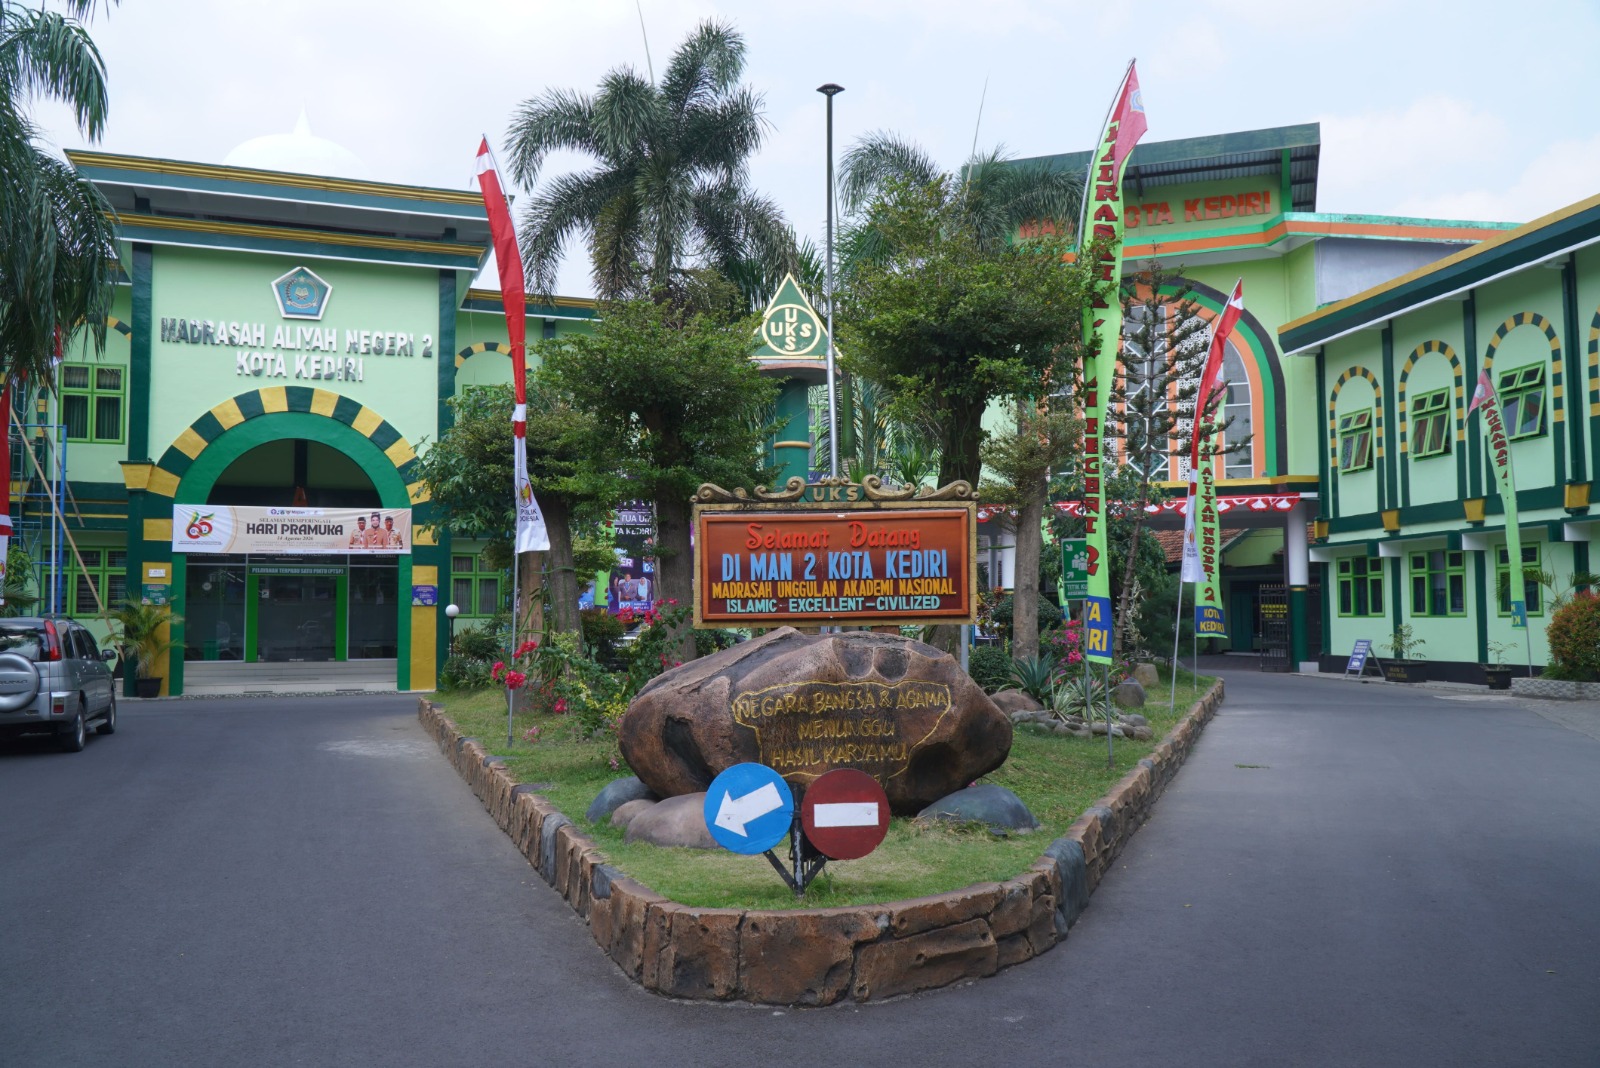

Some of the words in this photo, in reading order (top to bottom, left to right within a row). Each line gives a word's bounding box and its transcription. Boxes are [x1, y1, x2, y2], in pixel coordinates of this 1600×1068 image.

[1124, 201, 1174, 228] OTA
[1184, 191, 1272, 222] KEDIRI
[161, 317, 265, 347] MADRASAH
[273, 324, 337, 352] ALIYAH
[346, 330, 414, 357] NEGERI
[422, 334, 433, 358] 2
[770, 321, 812, 338] UKS
[237, 351, 287, 377] KOTA
[295, 355, 363, 382] KEDIRI
[813, 487, 858, 501] UKS
[1201, 467, 1215, 523] ALIYAH
[246, 523, 277, 534] HARI
[281, 524, 344, 536] PRAMUKA
[745, 522, 829, 549] Selamat
[848, 521, 920, 549] Datang
[722, 553, 740, 581] DI
[751, 552, 792, 581] MAN
[803, 553, 817, 580] 2
[828, 551, 873, 580] KOTA
[886, 549, 948, 579] KEDIRI
[1202, 527, 1215, 582] NEGERI
[712, 582, 772, 598] MADRASAH
[777, 581, 837, 598] UNGGULAN
[843, 579, 894, 597] AKADEMI
[899, 578, 957, 596] NASIONAL
[1204, 587, 1215, 601] 2
[727, 599, 777, 613] ISLAMIC
[788, 597, 864, 613] EXCELLENT
[877, 596, 940, 611] CIVILIZED
[1203, 608, 1220, 619] KOTA
[811, 688, 875, 714] BANGSA
[880, 690, 892, 707] &
[896, 689, 947, 710] AGAMA
[798, 719, 895, 740] MENUNGGU
[771, 747, 821, 767] HASIL
[823, 742, 907, 763] KARYAMU
